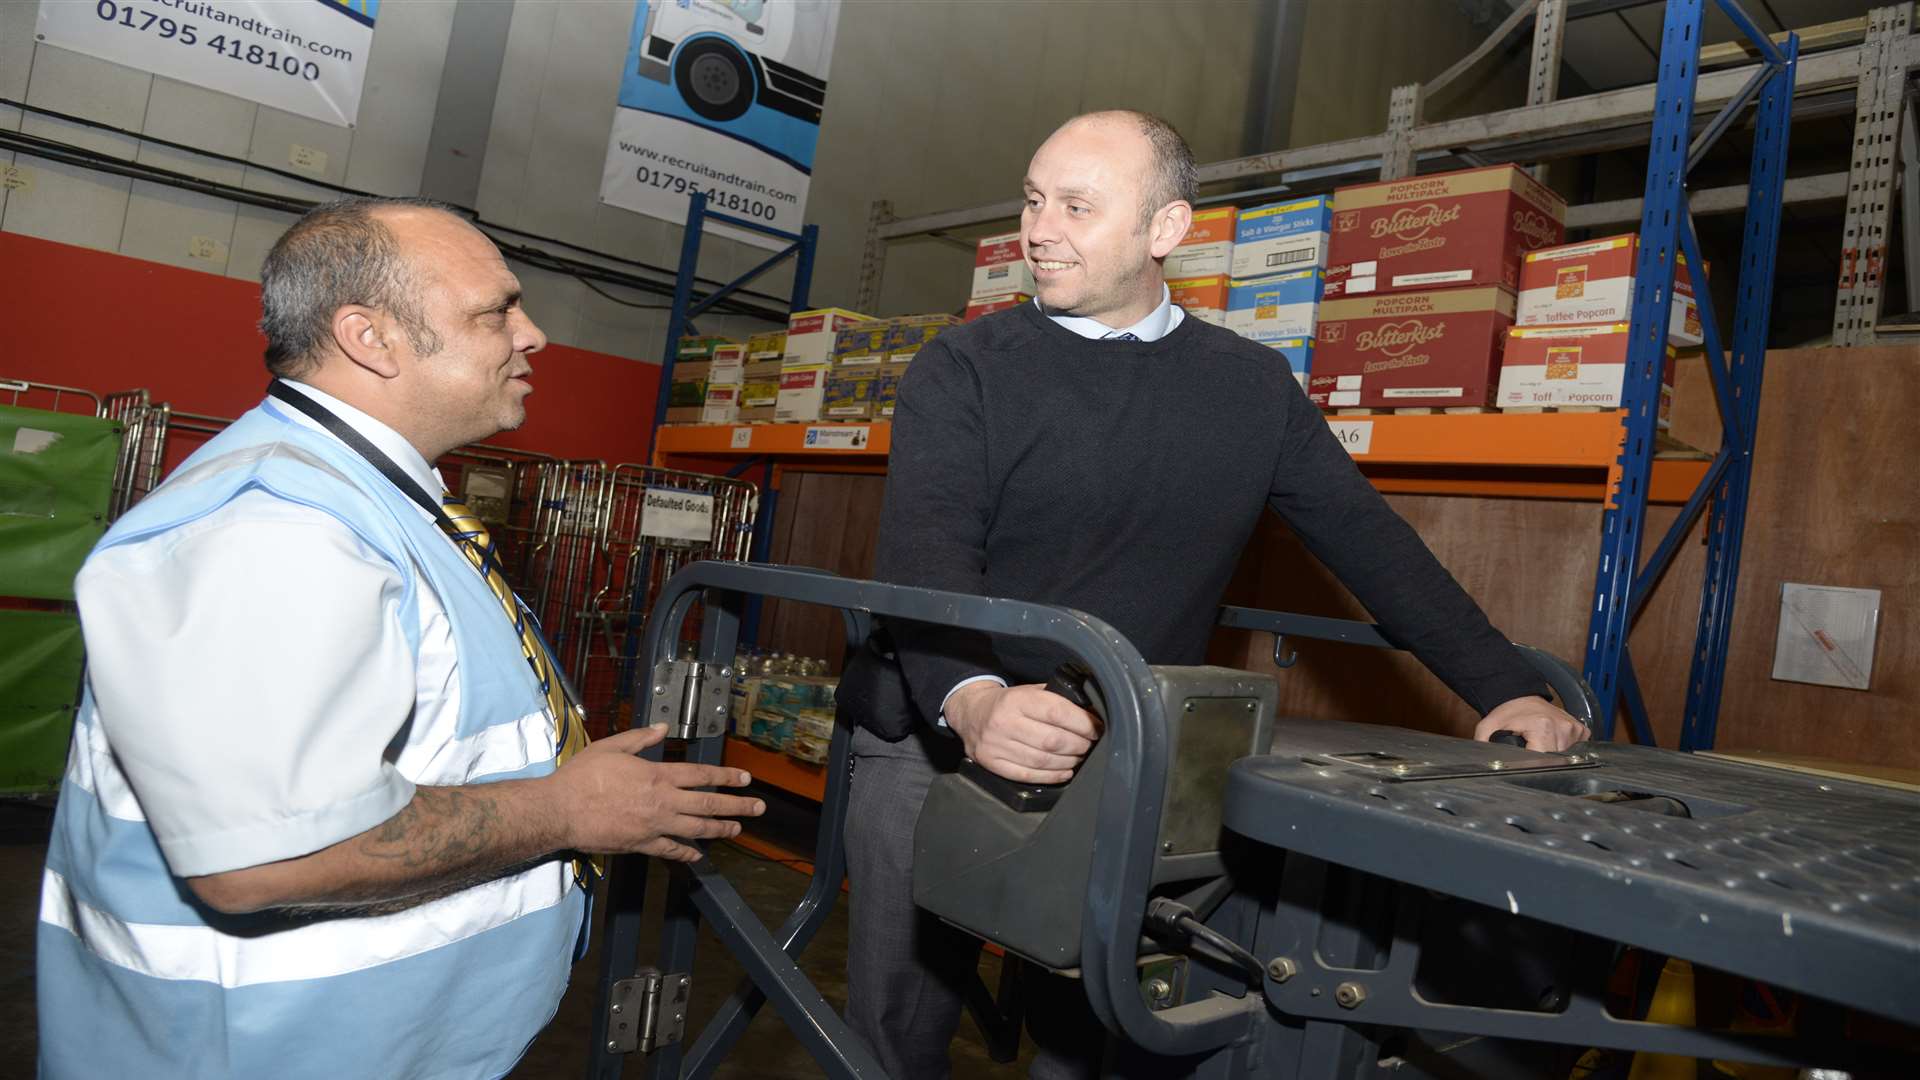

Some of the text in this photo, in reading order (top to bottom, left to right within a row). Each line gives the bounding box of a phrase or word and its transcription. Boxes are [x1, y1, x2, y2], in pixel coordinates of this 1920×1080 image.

[96, 0, 320, 82] 01795 418100
[619, 141, 797, 204] www.recruitandtrain.com
[636, 166, 776, 221] 01795 418100
[1386, 187, 1449, 202] MULTIPACK
[1389, 179, 1445, 194] POPCORN
[1370, 204, 1462, 239] Butterkist
[1376, 295, 1430, 307] POPCORN
[1372, 304, 1434, 315] MULTIPACK
[1545, 311, 1574, 323] Toffee
[1576, 307, 1616, 321] Popcorn
[1355, 321, 1447, 352] Butterkist
[1568, 393, 1613, 403] Popcorn
[1337, 428, 1360, 444] A6
[647, 494, 709, 514] Defaulted Goods
